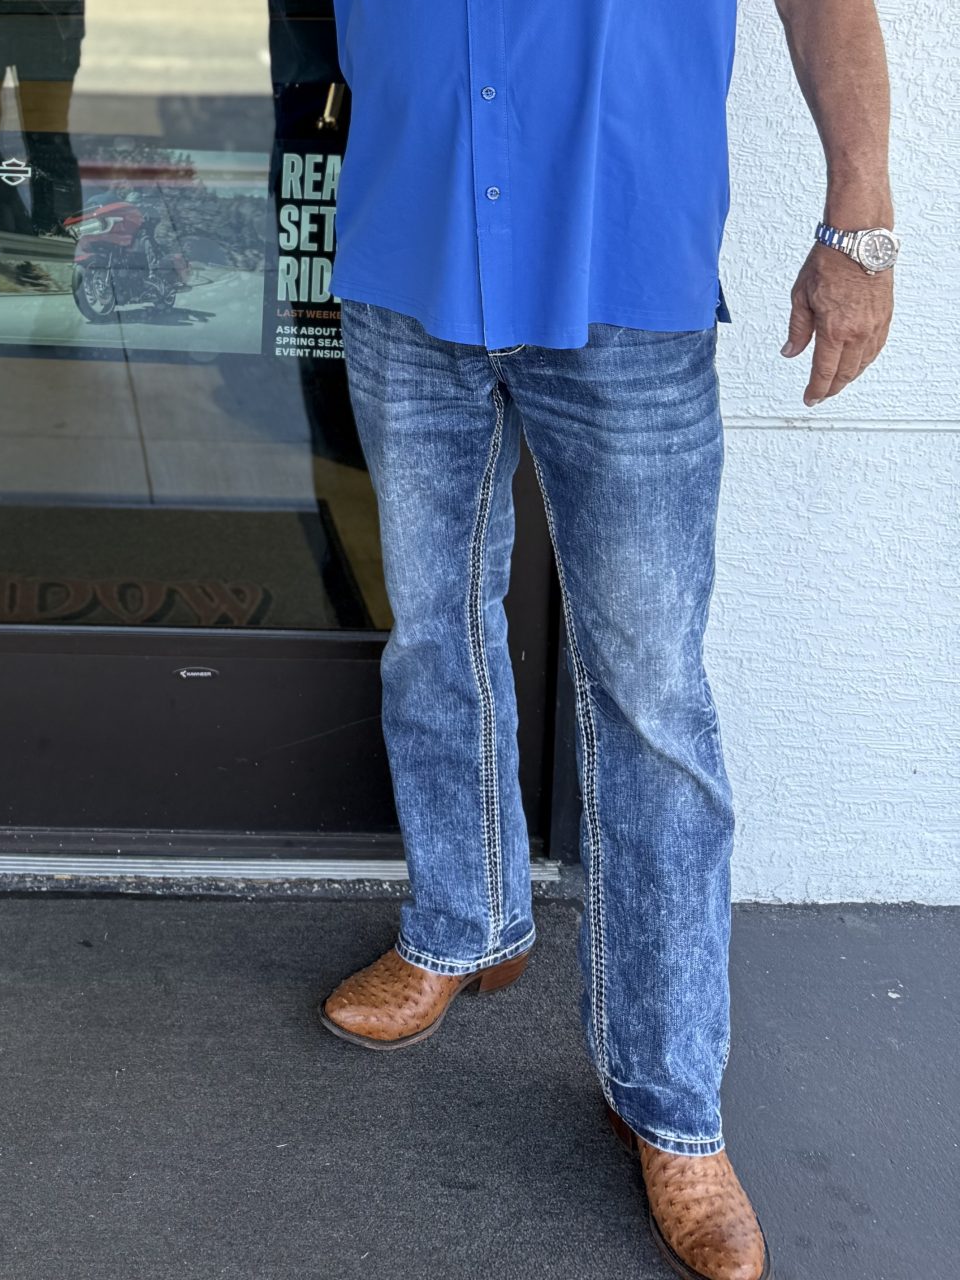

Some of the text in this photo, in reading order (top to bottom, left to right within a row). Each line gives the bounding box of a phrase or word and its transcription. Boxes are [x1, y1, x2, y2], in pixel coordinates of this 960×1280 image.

[279, 204, 336, 251] SET
[277, 256, 342, 303] RID
[277, 309, 304, 318] LAST
[276, 326, 337, 336] ASK ABOUT
[275, 337, 315, 346] SPRING
[275, 348, 310, 357] EVENT
